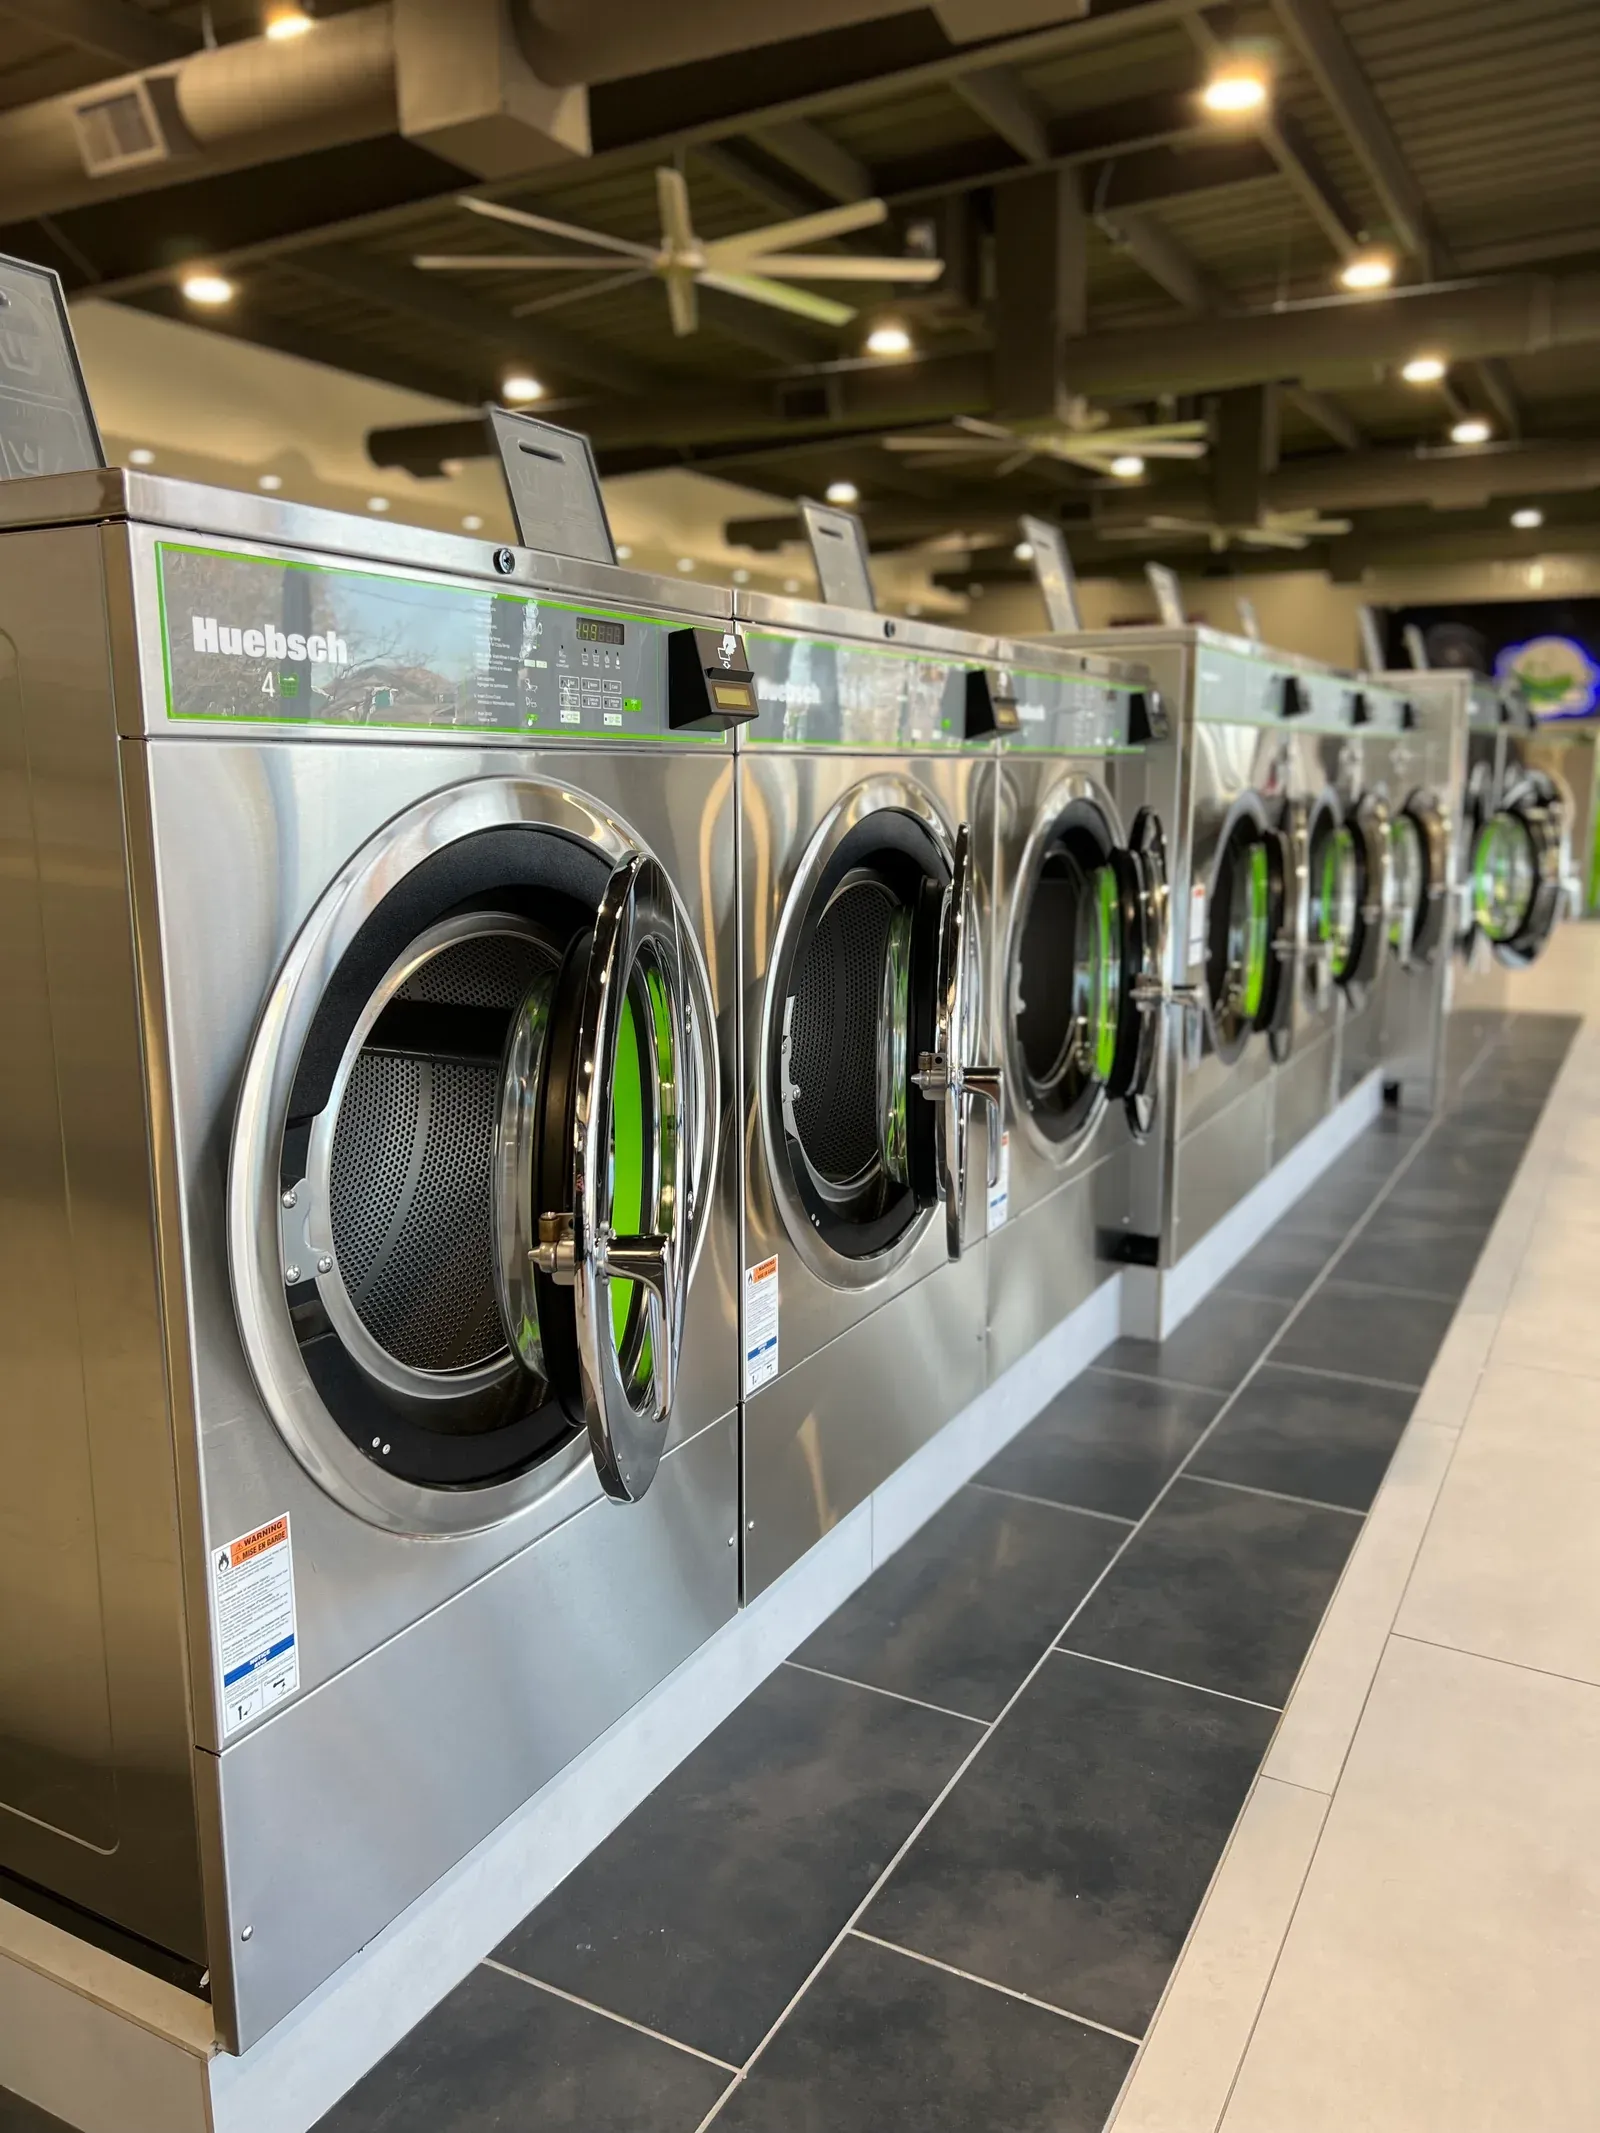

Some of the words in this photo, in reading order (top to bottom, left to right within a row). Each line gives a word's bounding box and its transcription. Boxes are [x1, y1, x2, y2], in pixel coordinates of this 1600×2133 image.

[192, 616, 348, 664] Huebsch
[261, 671, 276, 699] 4
[242, 1547, 257, 1560] MISE
[258, 1541, 266, 1549] EN
[267, 1531, 286, 1546] GARDE
[243, 1521, 283, 1547] WARNING
